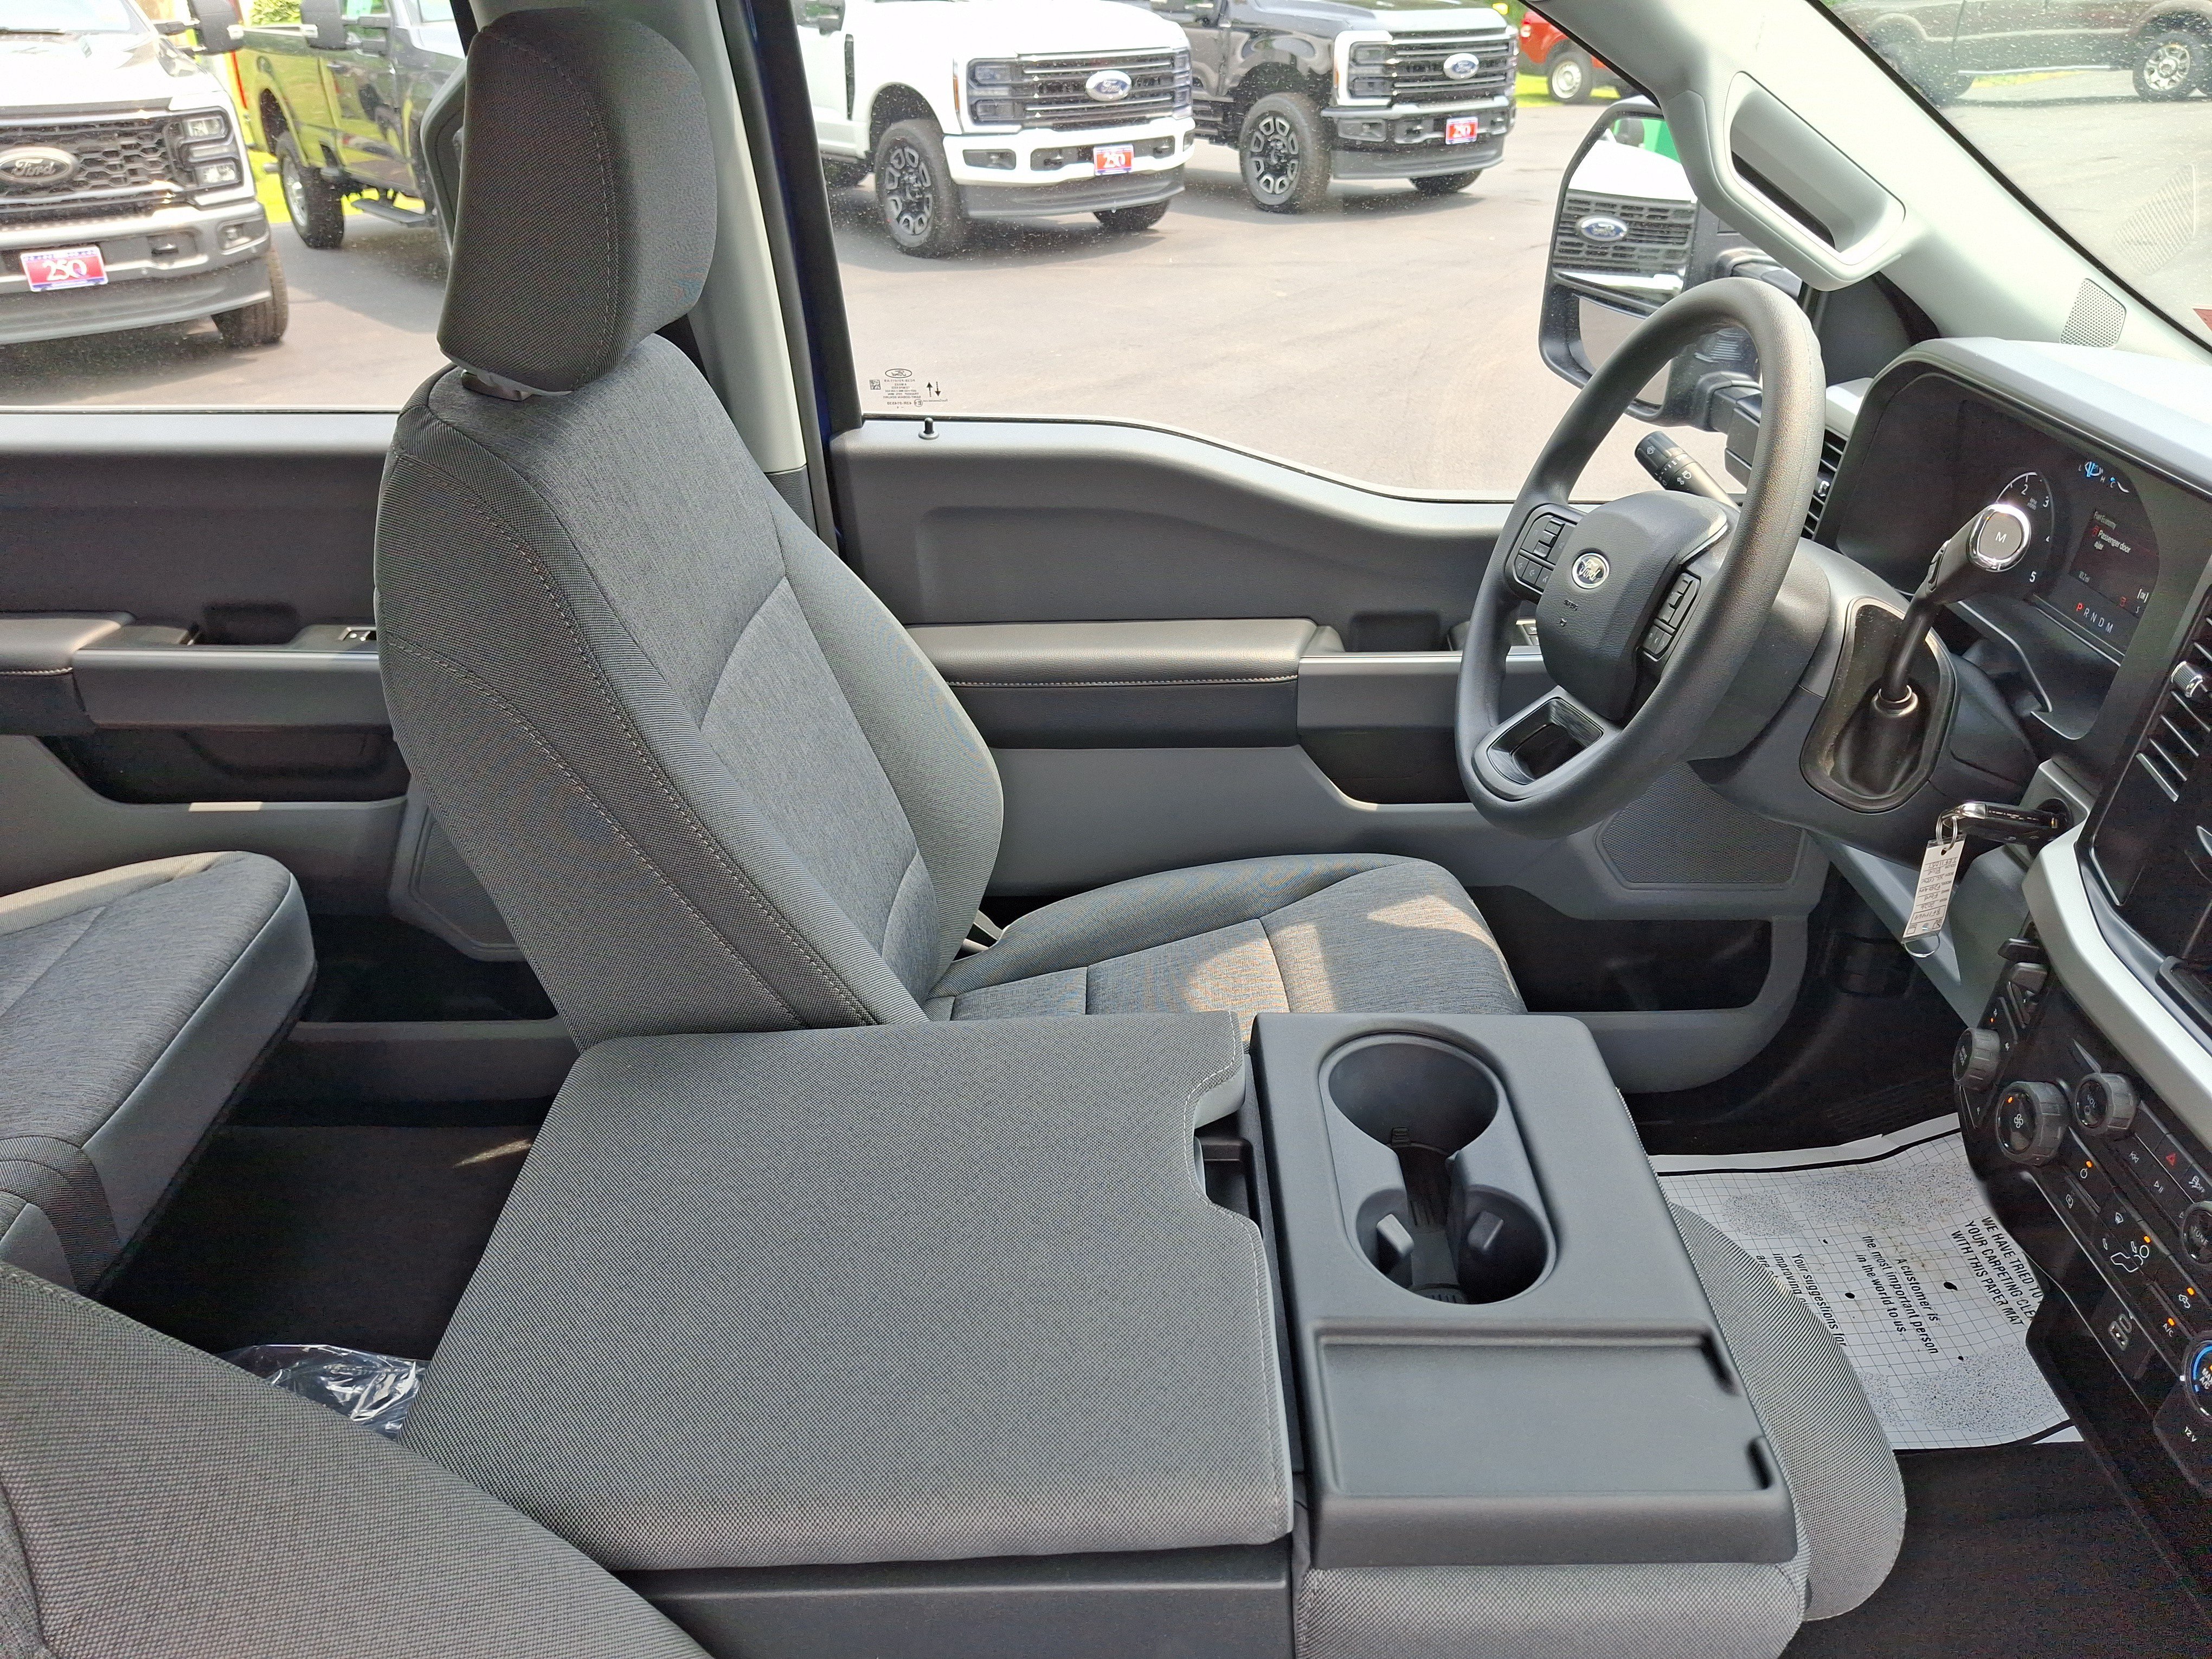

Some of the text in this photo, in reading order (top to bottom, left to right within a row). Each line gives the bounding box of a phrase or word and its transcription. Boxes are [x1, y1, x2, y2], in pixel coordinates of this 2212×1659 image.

[1100, 79, 1122, 93] Ford
[11, 158, 56, 176] Ford
[42, 259, 87, 281] 250
[2021, 484, 2028, 496] 2
[2042, 496, 2049, 508] 3
[1995, 531, 2007, 543] M
[2094, 541, 2104, 550] ajar
[2098, 529, 2131, 554] Passenger door
[1577, 558, 1600, 581] Ford
[2029, 571, 2037, 583] 5
[2076, 602, 2113, 633] P R N D M
[1924, 893, 1938, 901] Ford
[2087, 1094, 2096, 1109] VOL
[2193, 1225, 2209, 1248] TUNE
[1965, 1220, 1988, 1247] YOUR
[1981, 1248, 2023, 1297] CARPETING
[1981, 1216, 1999, 1232] WE
[1991, 1233, 2016, 1258] HAVE
[2009, 1258, 2035, 1284] TRIED
[1756, 1255, 1771, 1268] are
[1772, 1253, 1803, 1295] improving
[1951, 1230, 2024, 1326] WITH THIS PAPER MAT
[1855, 1255, 1867, 1263] in
[1861, 1264, 1876, 1277] the
[1871, 1278, 1895, 1306] world
[1886, 1308, 1899, 1317] to
[1862, 1236, 1939, 1354] the most important person
[1900, 1265, 1933, 1310] customer
[1926, 1313, 1939, 1322] is
[1792, 1253, 1810, 1272] Your
[1803, 1275, 1838, 1330] suggestions
[1832, 1333, 1847, 1346] for
[2162, 1323, 2174, 1338] A/C
[2199, 1377, 2210, 1390] A/C
[2184, 1426, 2197, 1442] 12V
